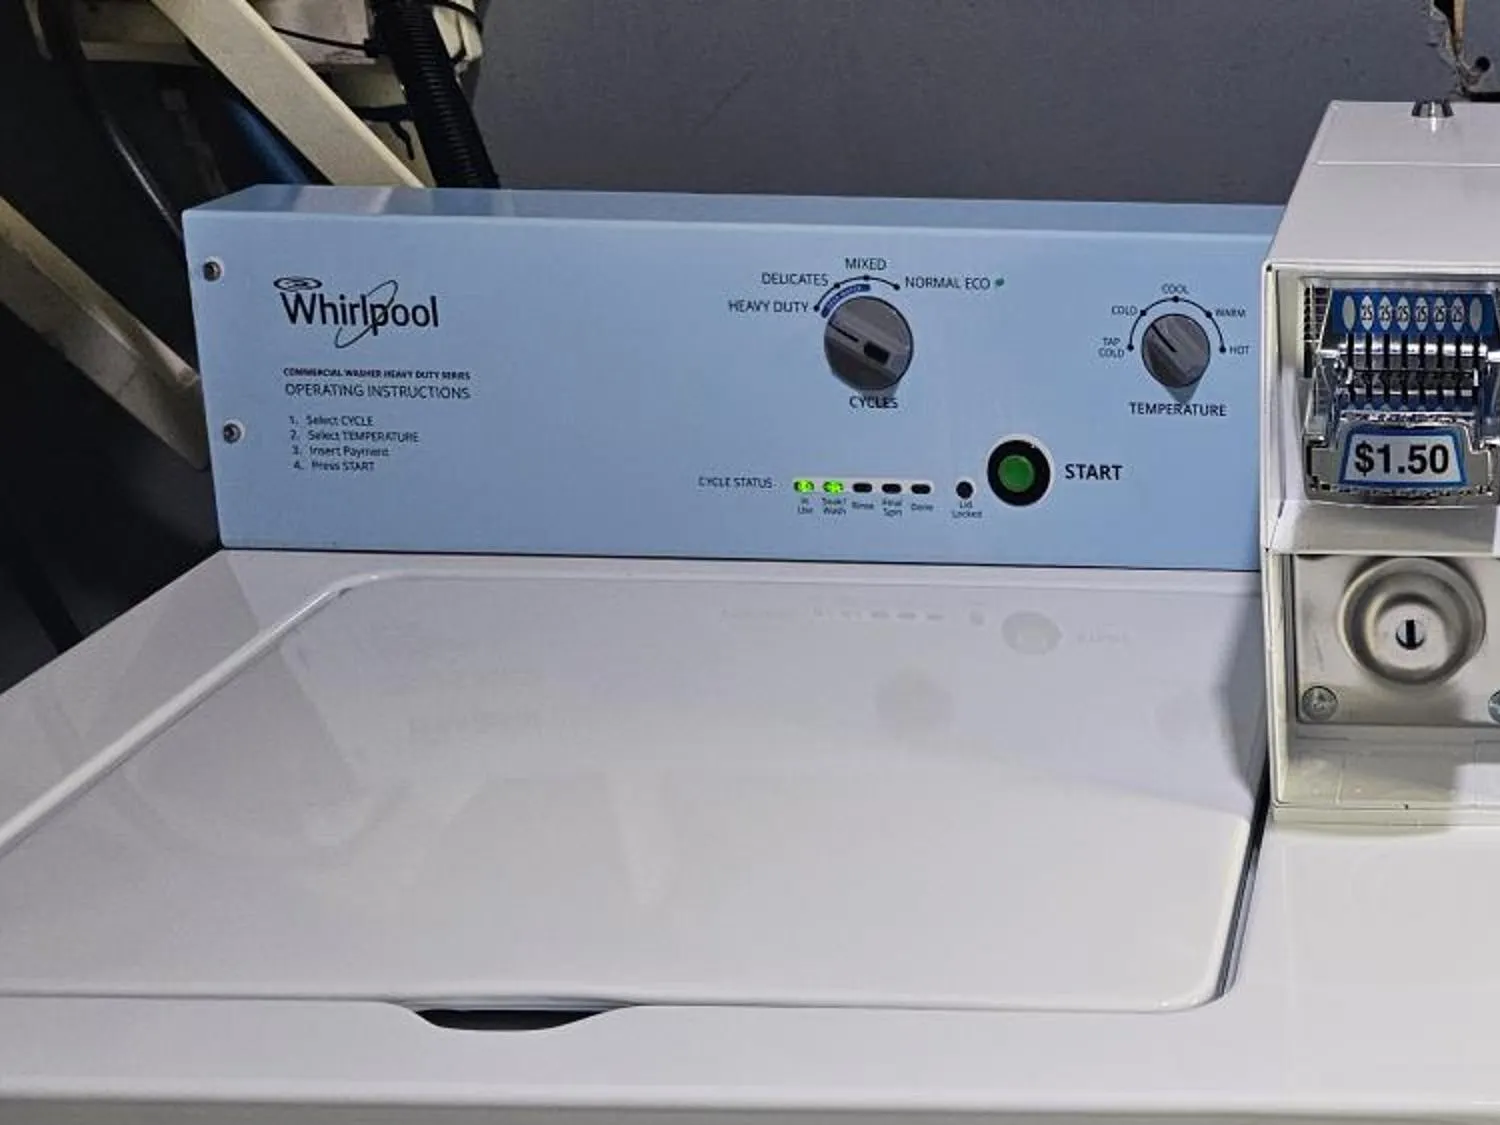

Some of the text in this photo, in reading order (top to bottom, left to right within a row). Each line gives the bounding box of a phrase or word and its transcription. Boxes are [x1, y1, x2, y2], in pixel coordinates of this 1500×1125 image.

[845, 258, 887, 270] MIXED
[761, 273, 829, 286] DELICATES
[905, 276, 991, 289] NORMAL ECO
[1161, 284, 1189, 295] COOL
[728, 300, 809, 313] HEAVY DUTY
[1111, 305, 1138, 316] COLD
[1215, 307, 1246, 318] WARM
[279, 291, 439, 337] Whirlpool
[1103, 337, 1121, 346] TAP
[1098, 348, 1125, 358] COLD
[1229, 345, 1249, 355] HOT
[283, 367, 344, 377] COMMERCIAL
[344, 368, 382, 378] WASHER
[384, 369, 413, 379] HEAVY
[415, 370, 439, 380] DUTY
[285, 383, 471, 400] OPERATING INSTRUCTIONS
[849, 395, 898, 409] CYCLES
[1129, 401, 1228, 417] TEMPERATURE
[306, 415, 339, 426] Select
[341, 416, 374, 427] CYCLE
[308, 430, 340, 441] Select
[342, 431, 420, 443] TEMPERATURE
[309, 446, 341, 457] Insert
[343, 447, 390, 459] Payment
[1354, 440, 1449, 477] $1.50
[312, 461, 340, 471] Press
[342, 461, 375, 471] START
[1064, 463, 1124, 481] START
[698, 476, 773, 489] CYCLE STATUS
[959, 500, 973, 509] Lid
